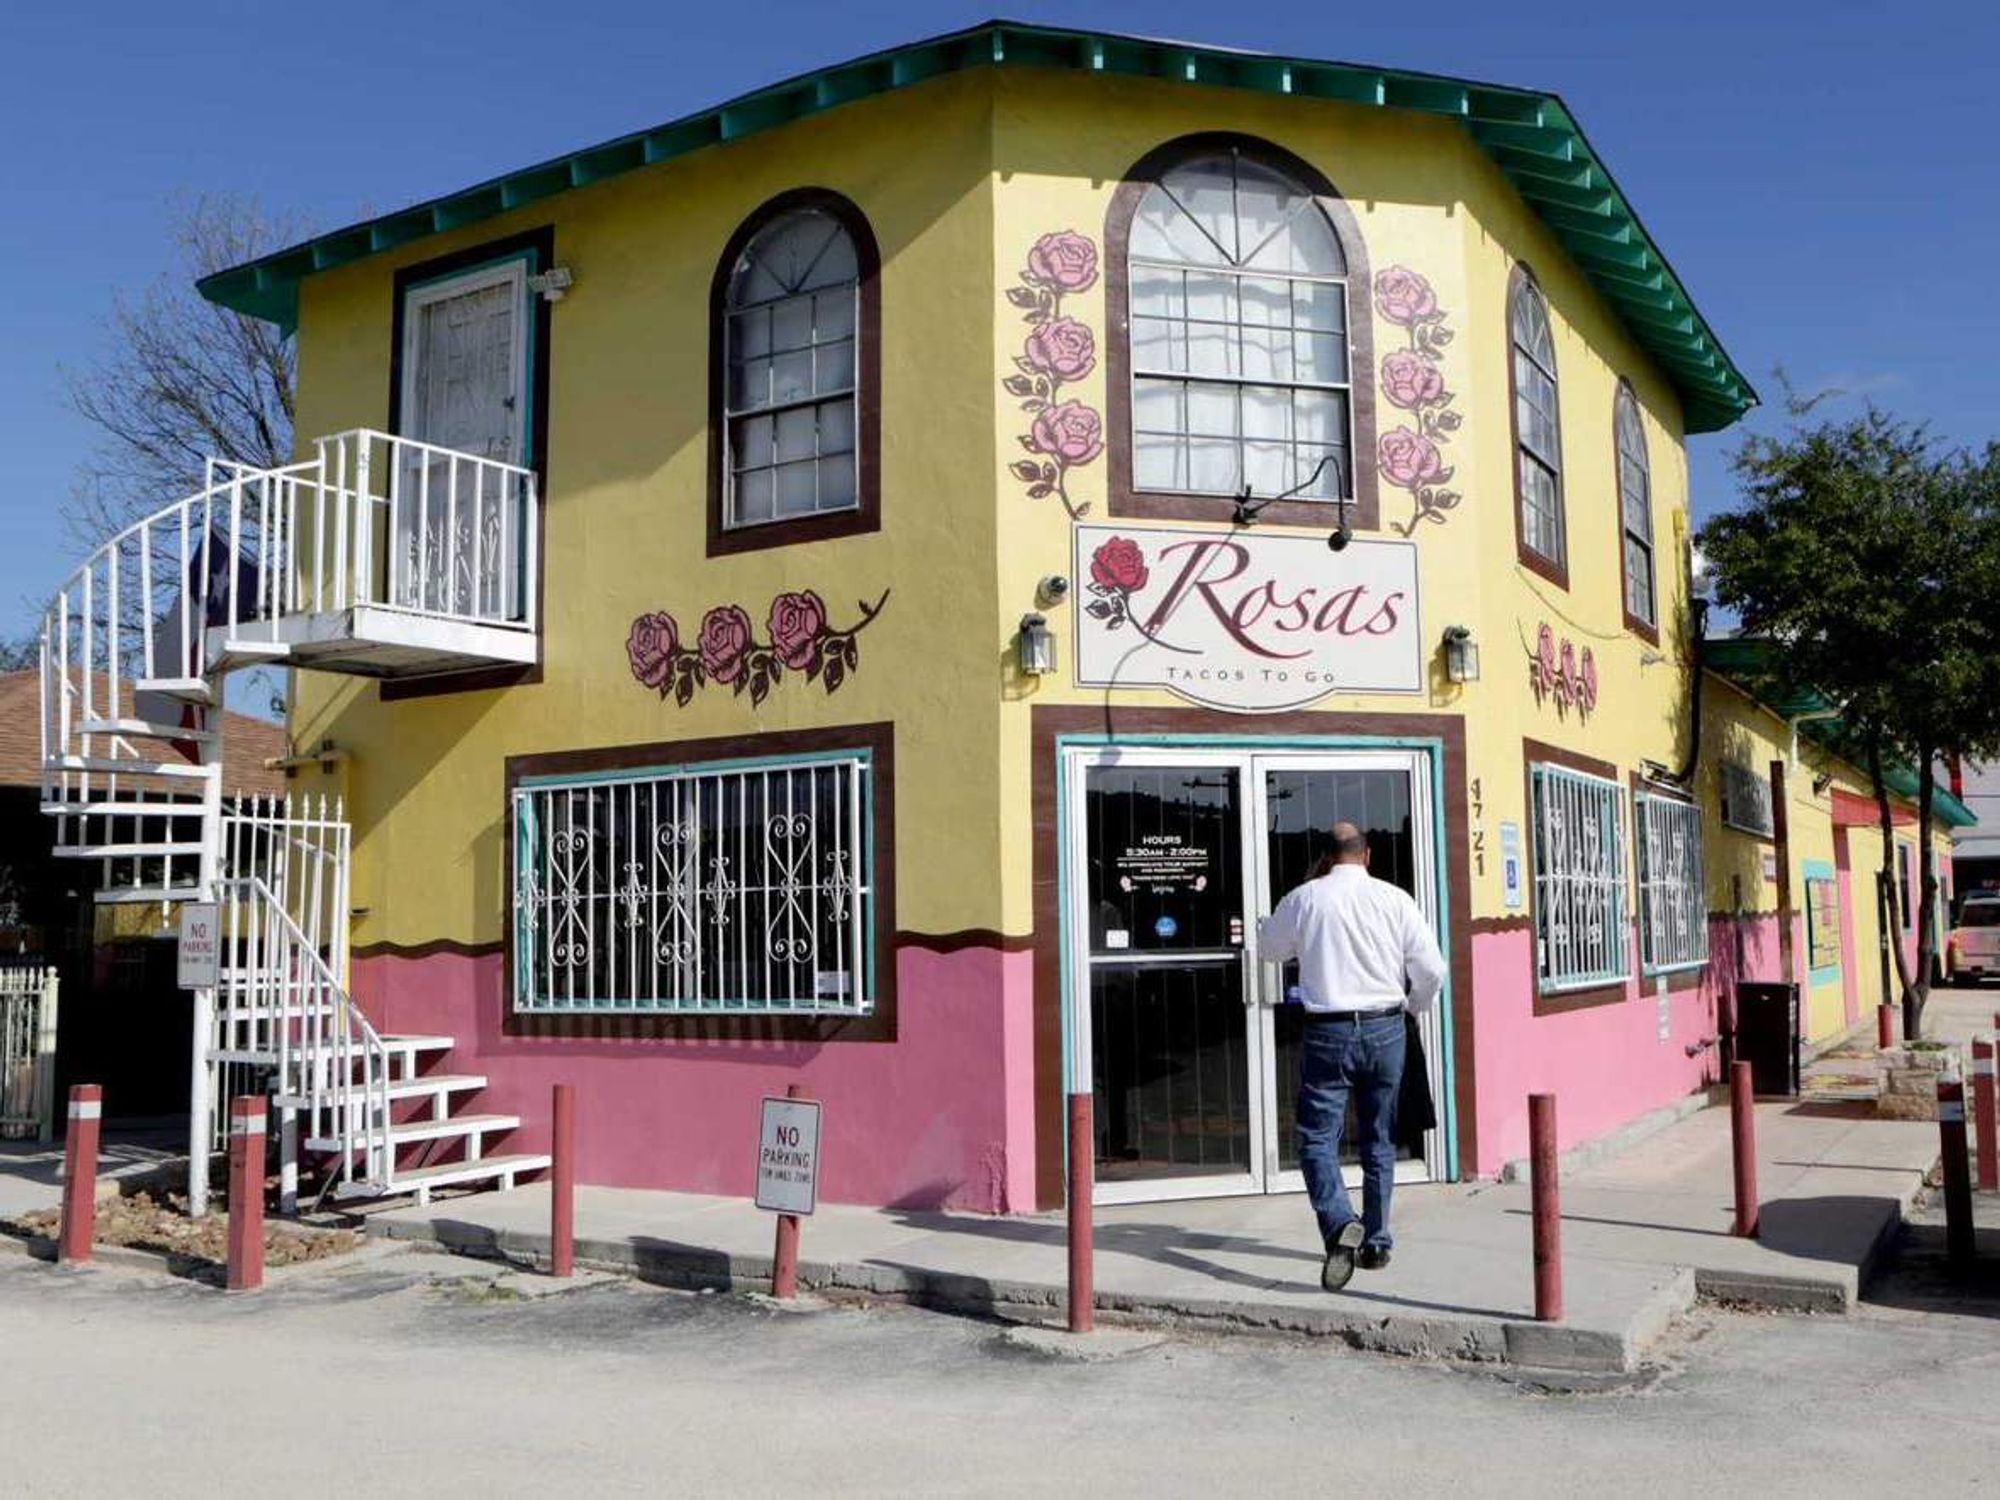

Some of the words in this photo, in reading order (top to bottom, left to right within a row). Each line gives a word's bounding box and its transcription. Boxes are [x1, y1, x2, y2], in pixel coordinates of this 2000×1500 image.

[1144, 540, 1404, 659] Rosas
[1167, 666, 1245, 681] TACOS
[1262, 669, 1288, 683] TO
[1304, 671, 1334, 684] GO
[1142, 835, 1182, 845] HOURS
[191, 922, 207, 939] NO
[776, 1125, 800, 1148] NO
[762, 1147, 811, 1169] PARKING
